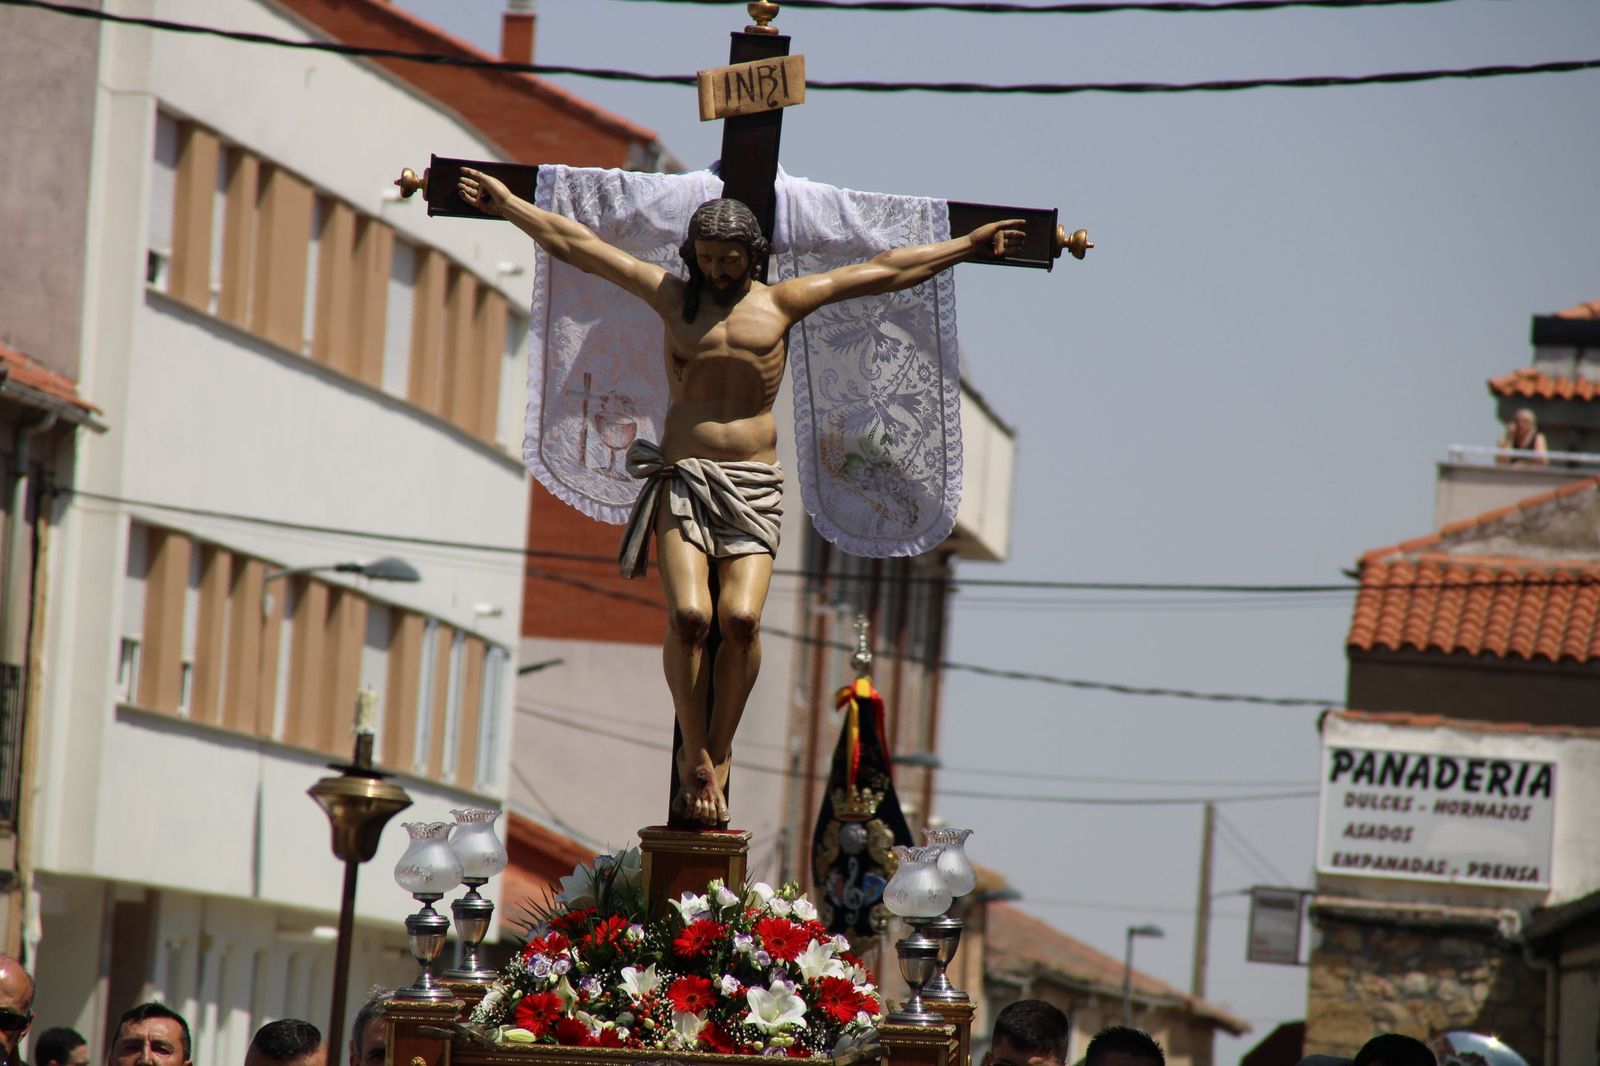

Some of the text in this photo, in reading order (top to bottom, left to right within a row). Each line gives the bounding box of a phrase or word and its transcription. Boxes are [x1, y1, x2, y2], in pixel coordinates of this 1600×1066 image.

[724, 61, 790, 108] INRI
[1329, 749, 1552, 799] PANADERIA
[1344, 792, 1414, 811] DULCES
[1433, 797, 1533, 821] HORNAZOS
[1343, 823, 1415, 843] ASADOS
[1331, 852, 1447, 876] EMPANADAS
[1466, 861, 1540, 883] PRENSA
